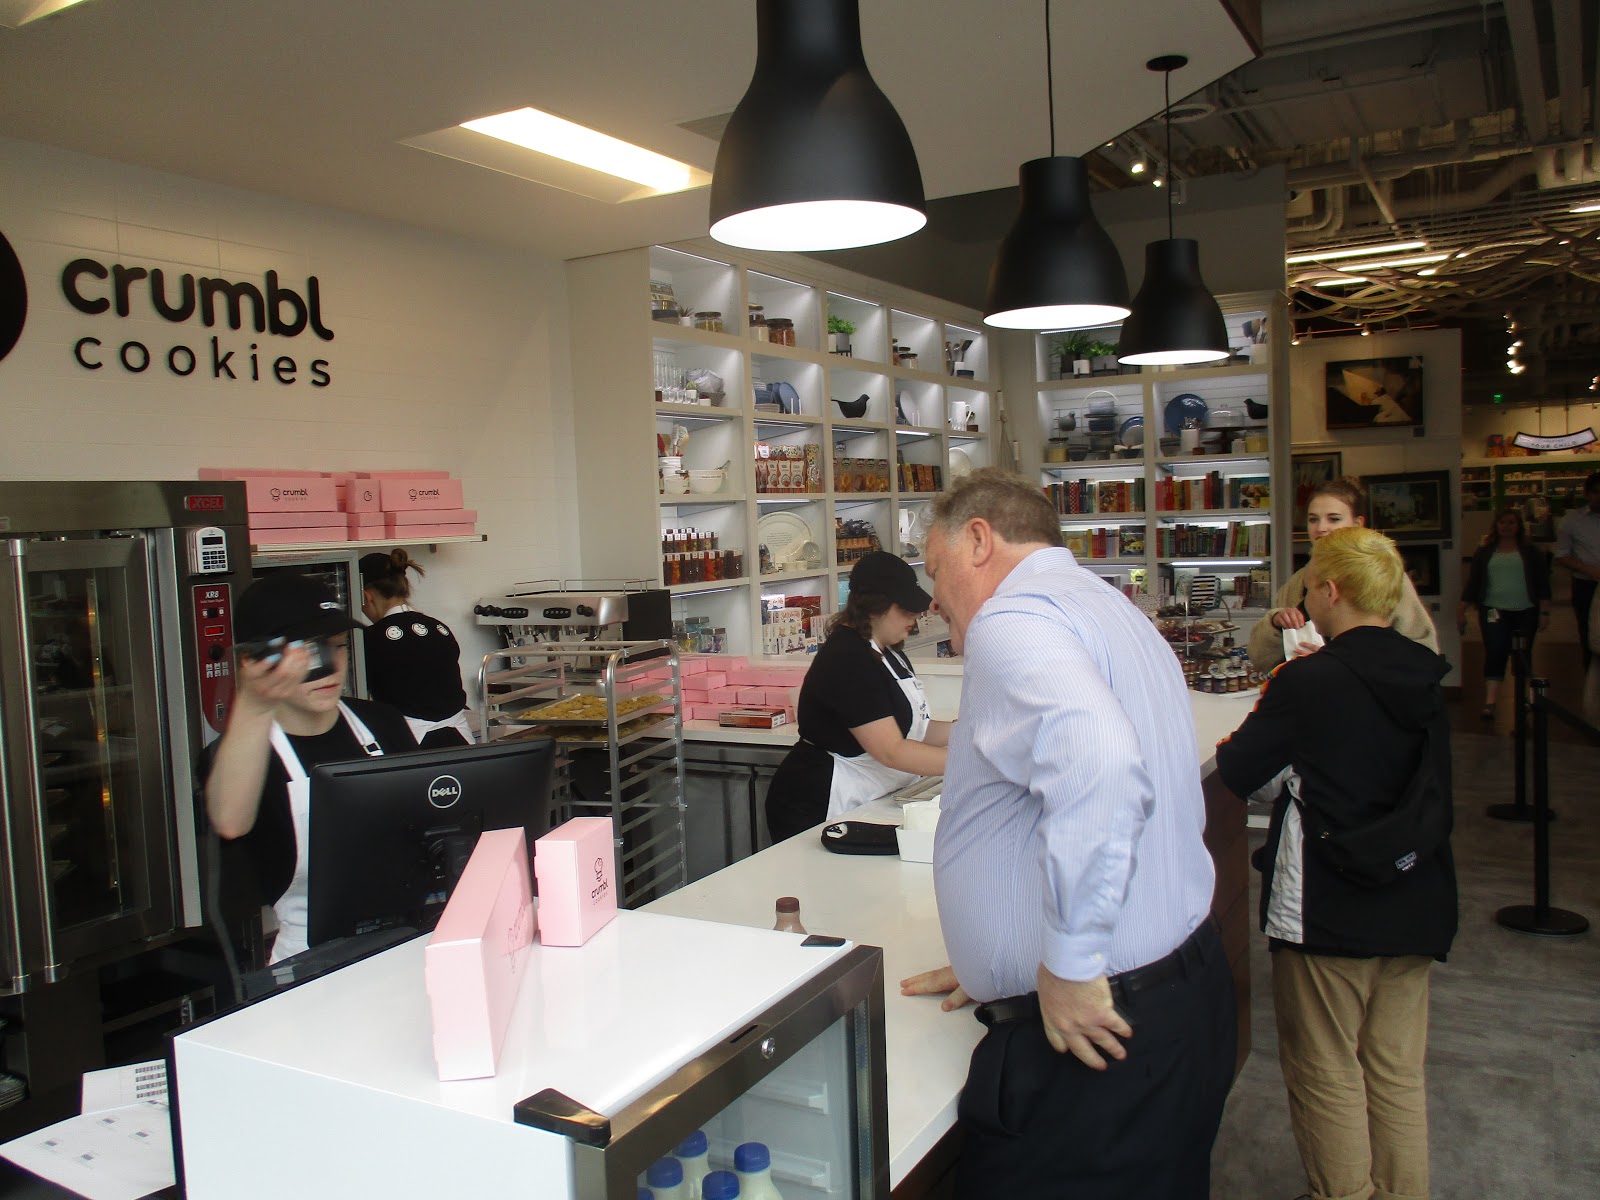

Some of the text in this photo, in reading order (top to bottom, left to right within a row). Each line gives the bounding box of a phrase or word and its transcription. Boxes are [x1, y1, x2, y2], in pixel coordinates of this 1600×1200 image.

[62, 258, 334, 341] crumbl
[74, 335, 331, 387] cookies
[282, 488, 308, 496] crumbl
[418, 488, 440, 496] crumbl
[432, 786, 458, 798] DELL
[591, 878, 609, 899] crumbl
